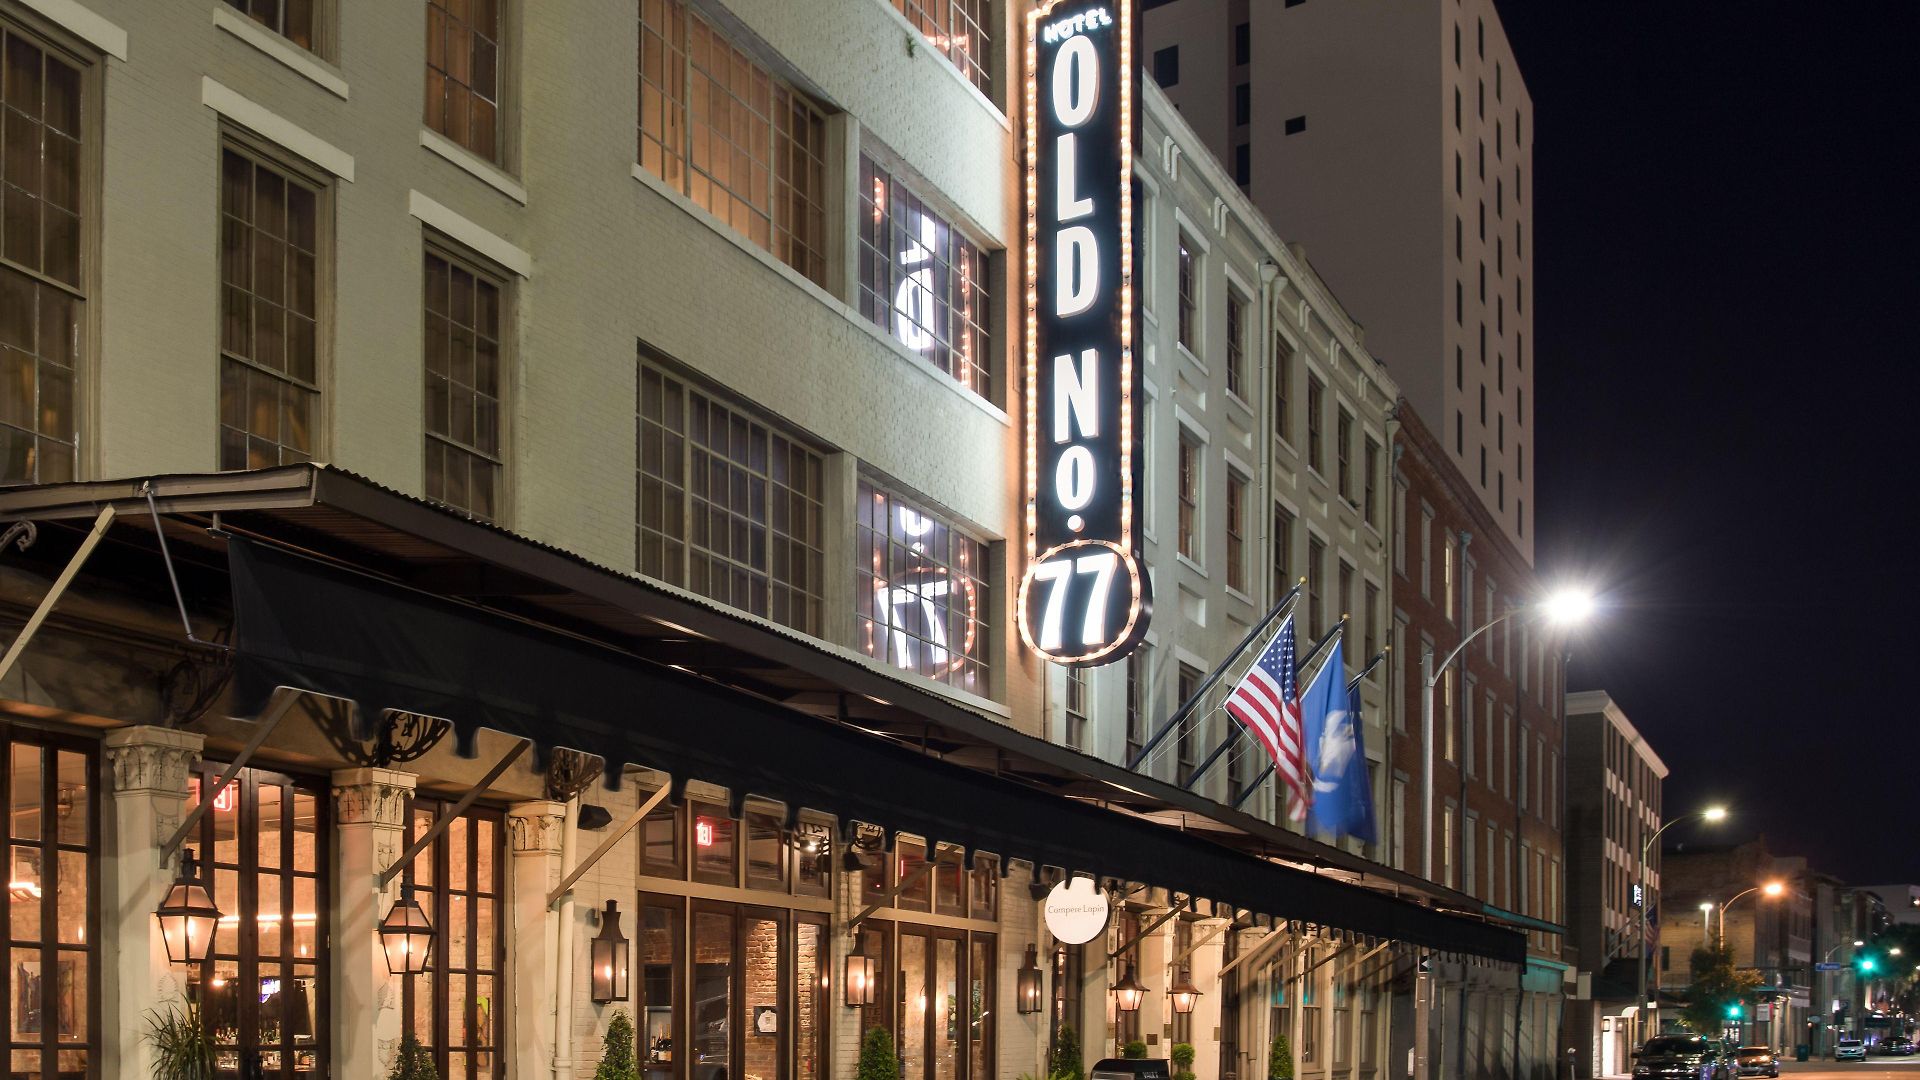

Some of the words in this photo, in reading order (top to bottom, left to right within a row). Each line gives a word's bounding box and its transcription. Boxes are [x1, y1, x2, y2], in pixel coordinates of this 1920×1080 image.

[1044, 7, 1112, 43] HOTEL
[1053, 35, 1099, 318] OLD
[1034, 553, 1117, 650] 77
[1083, 904, 1105, 916] Lapin
